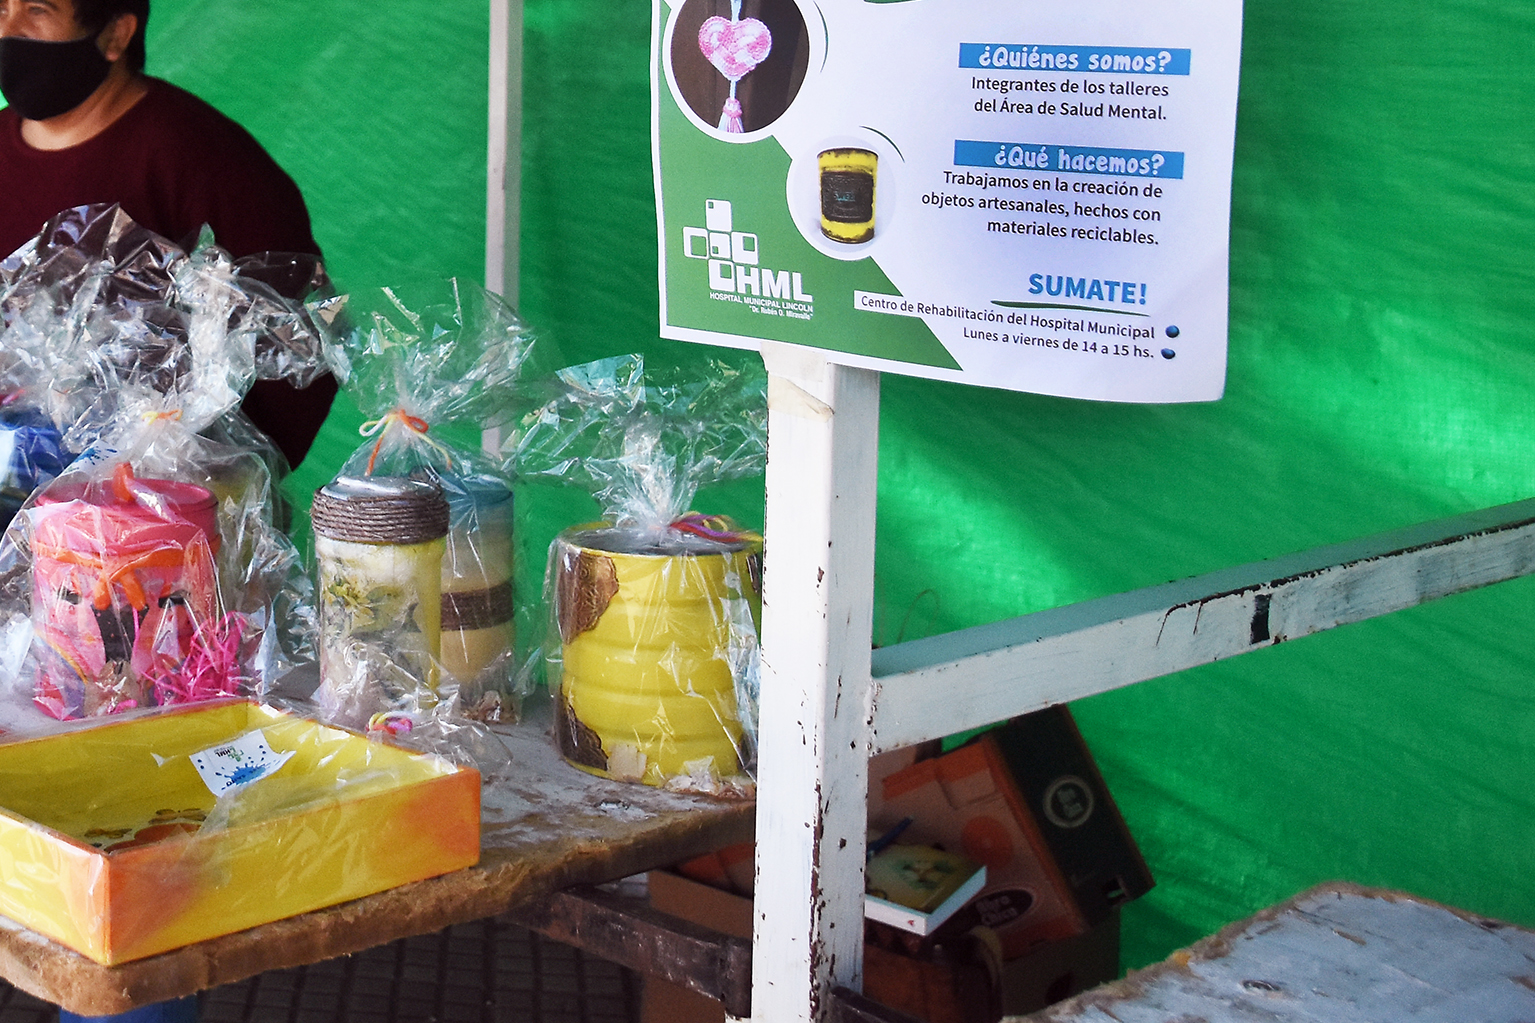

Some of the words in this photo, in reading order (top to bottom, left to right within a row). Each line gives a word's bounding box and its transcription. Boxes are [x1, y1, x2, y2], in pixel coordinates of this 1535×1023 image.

[978, 45, 1079, 69] ¿Quiénes
[1088, 50, 1172, 72] somos?
[971, 76, 1056, 94] Integrantes
[1060, 79, 1079, 94] de
[1083, 79, 1105, 94] los
[1109, 81, 1169, 97] talleres
[974, 98, 996, 113] del
[1000, 97, 1033, 114] Área
[1037, 100, 1056, 115] de
[1060, 102, 1103, 117] Salud
[1108, 104, 1167, 120] Mental.
[994, 144, 1049, 169] ¿Qué
[1058, 148, 1165, 175] hacemos?
[943, 171, 1029, 190] Trabajamos
[1032, 178, 1051, 191] en
[1055, 177, 1068, 192] la
[1072, 180, 1137, 197] creación
[1143, 183, 1162, 198] de
[921, 191, 974, 209] objetos
[978, 195, 1069, 217] artesanales,
[1074, 202, 1129, 219] hechos
[1133, 208, 1161, 221] con
[987, 218, 1067, 238] materiales
[1071, 224, 1159, 245] reciclables.
[709, 291, 743, 303] HOSPITAL
[744, 296, 781, 308] MUNICIPAL
[782, 301, 813, 313] LINCOLN
[1028, 272, 1147, 305] SUMATE!
[861, 295, 898, 310] Centro
[900, 299, 914, 313] de
[917, 302, 1004, 323] Rehabilitación
[1007, 311, 1027, 326] del
[1030, 315, 1084, 332] Hospital
[1088, 321, 1155, 340] Municipal
[963, 327, 998, 342] Lunes
[1002, 332, 1010, 343] a
[1013, 332, 1059, 349] viernes
[1062, 337, 1079, 351] de
[1082, 341, 1097, 353] 14
[1101, 344, 1109, 355] a
[1113, 344, 1129, 356] 15
[1133, 344, 1154, 358] hs.
